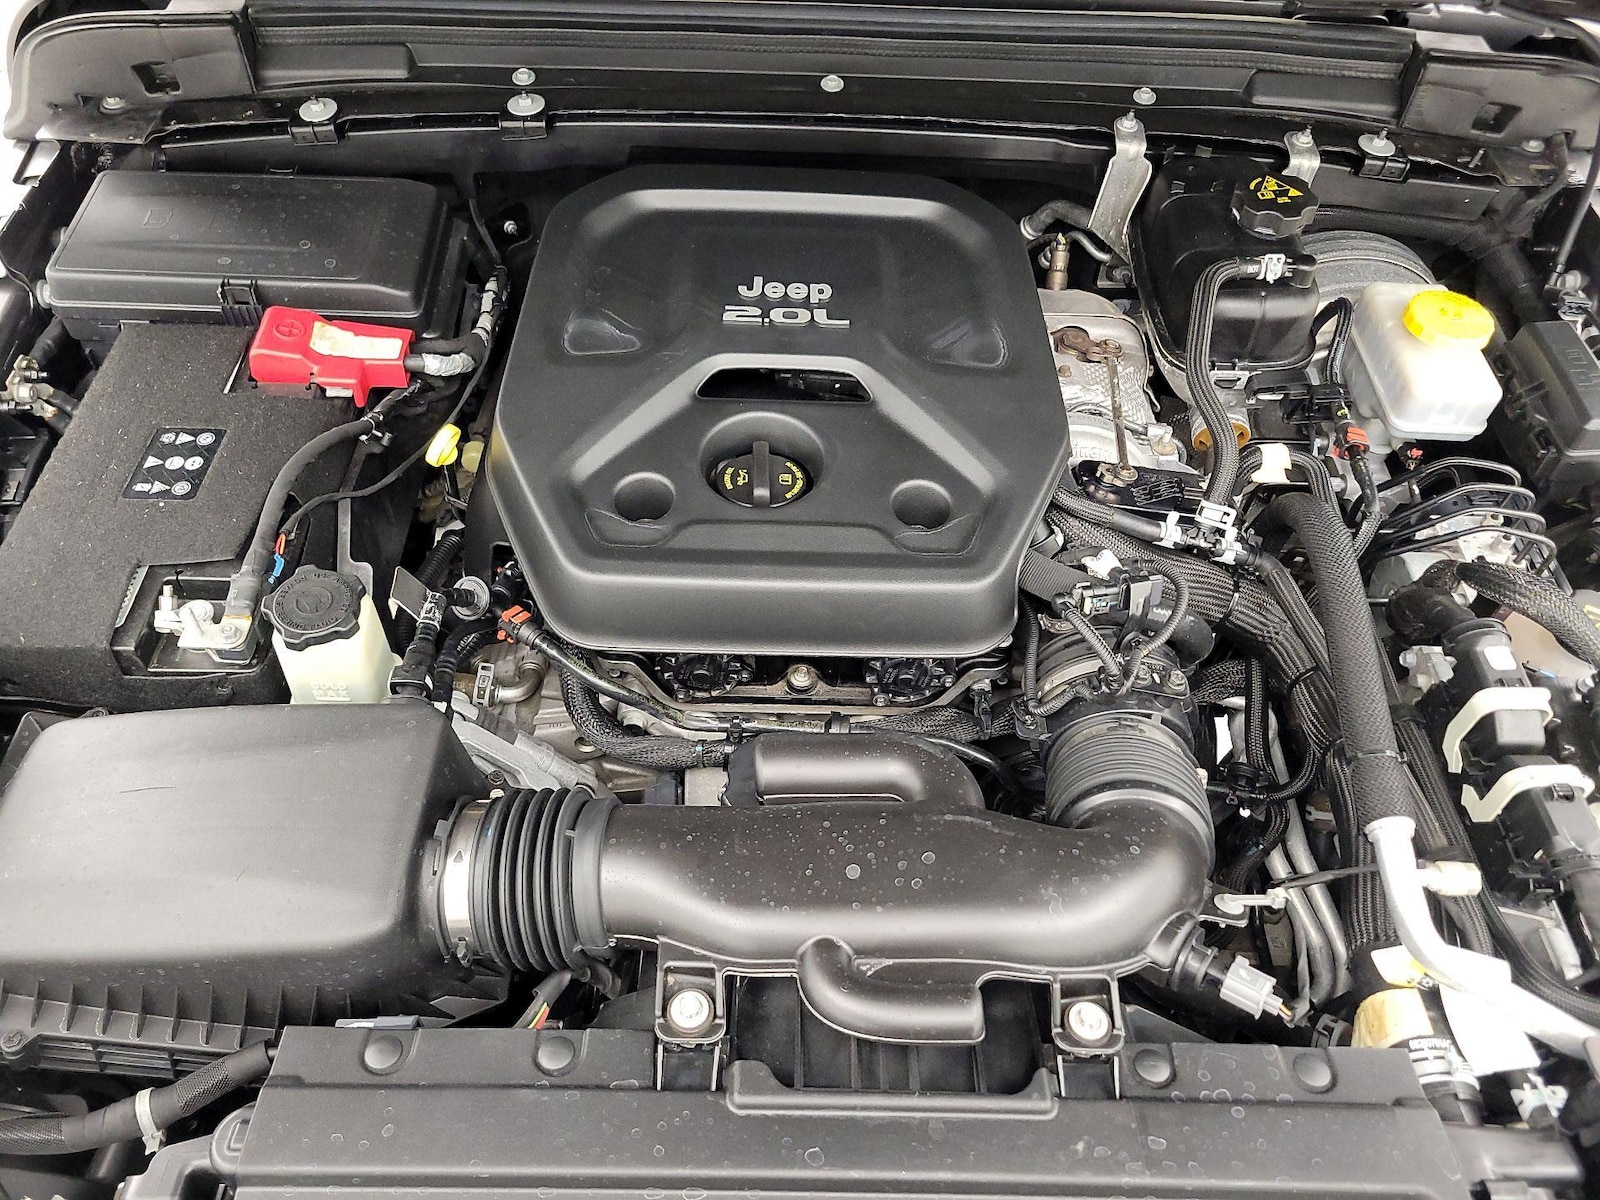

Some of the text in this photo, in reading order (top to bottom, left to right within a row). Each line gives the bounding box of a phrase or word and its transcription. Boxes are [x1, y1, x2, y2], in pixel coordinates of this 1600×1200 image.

[738, 275, 833, 305] Jeep
[722, 304, 851, 327] 2.0L
[310, 680, 347, 690] COLD
[311, 689, 350, 698] MAX
